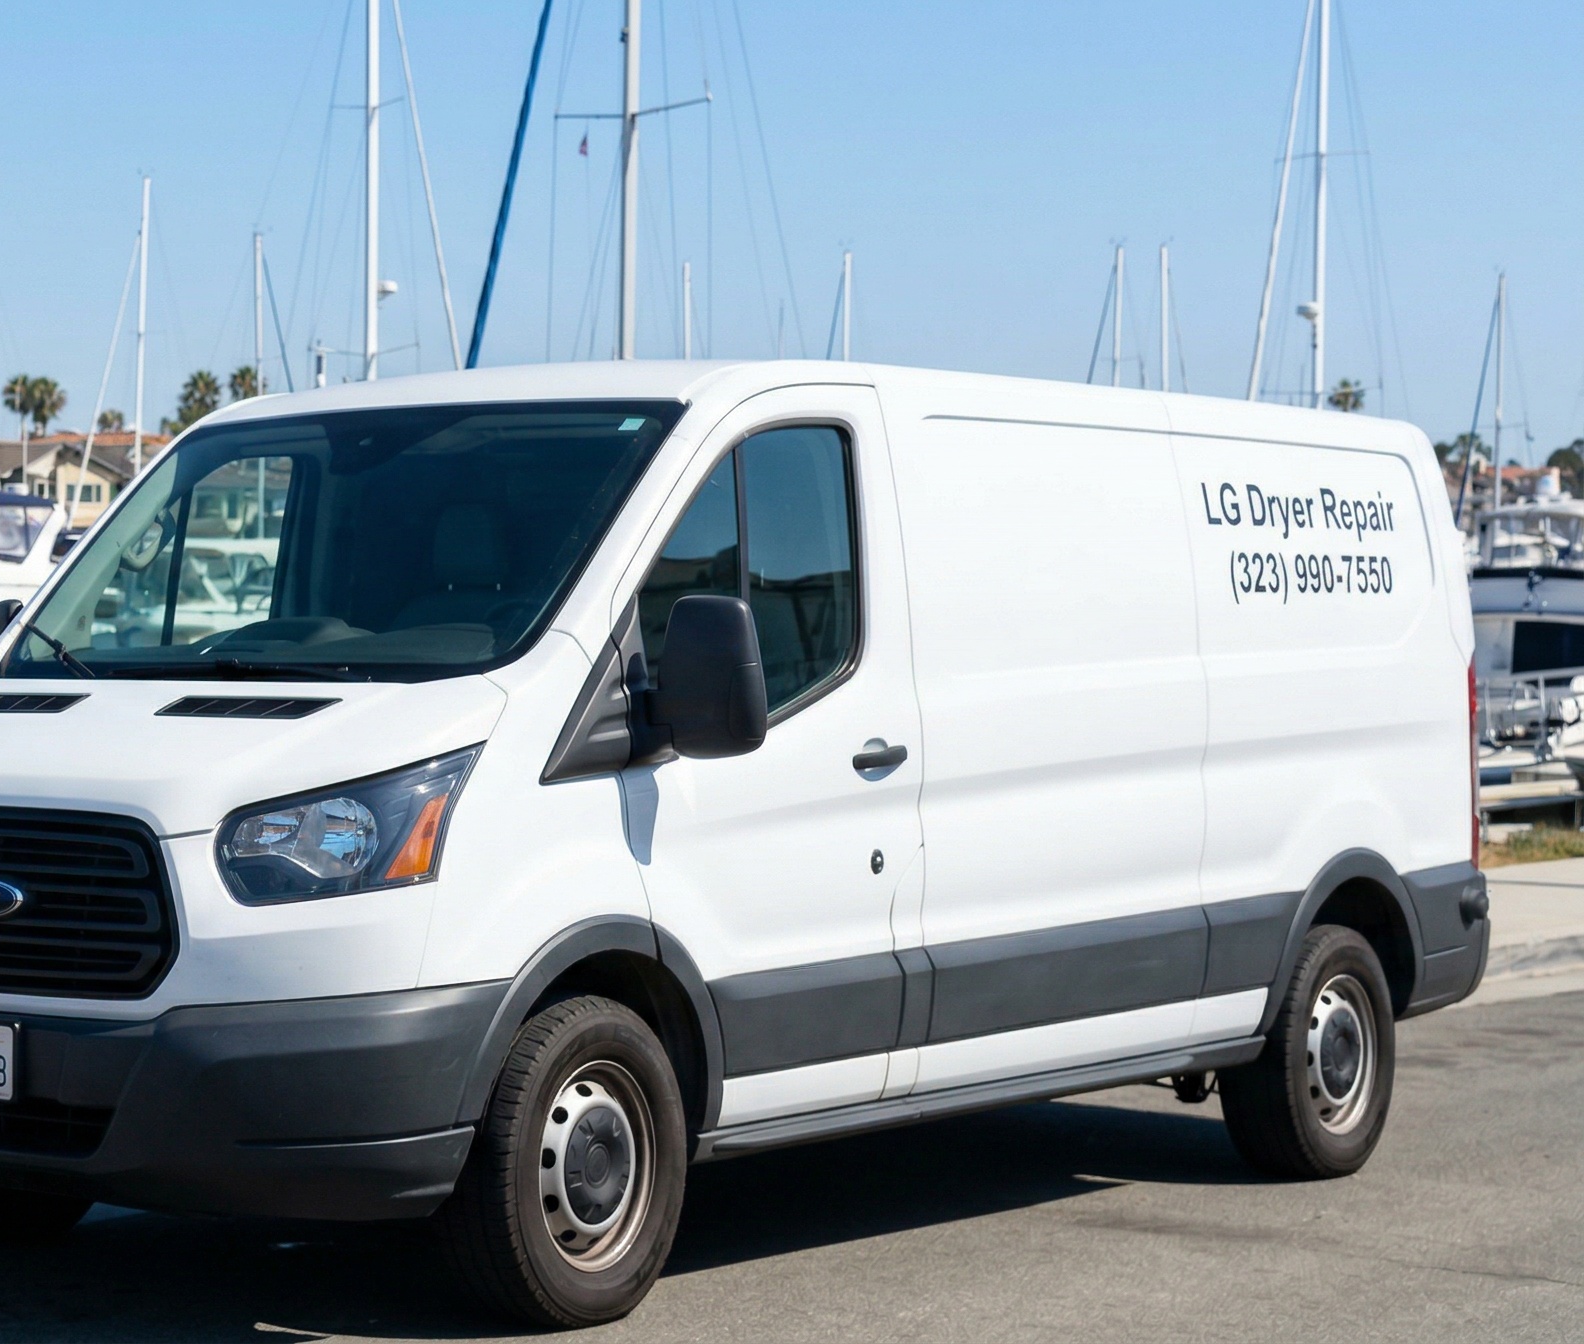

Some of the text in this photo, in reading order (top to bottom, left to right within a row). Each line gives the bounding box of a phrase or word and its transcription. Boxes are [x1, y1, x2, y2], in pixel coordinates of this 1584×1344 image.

[1201, 482, 1394, 542] LG Dryer Repair
[1230, 550, 1393, 604] (323) 990-7550
